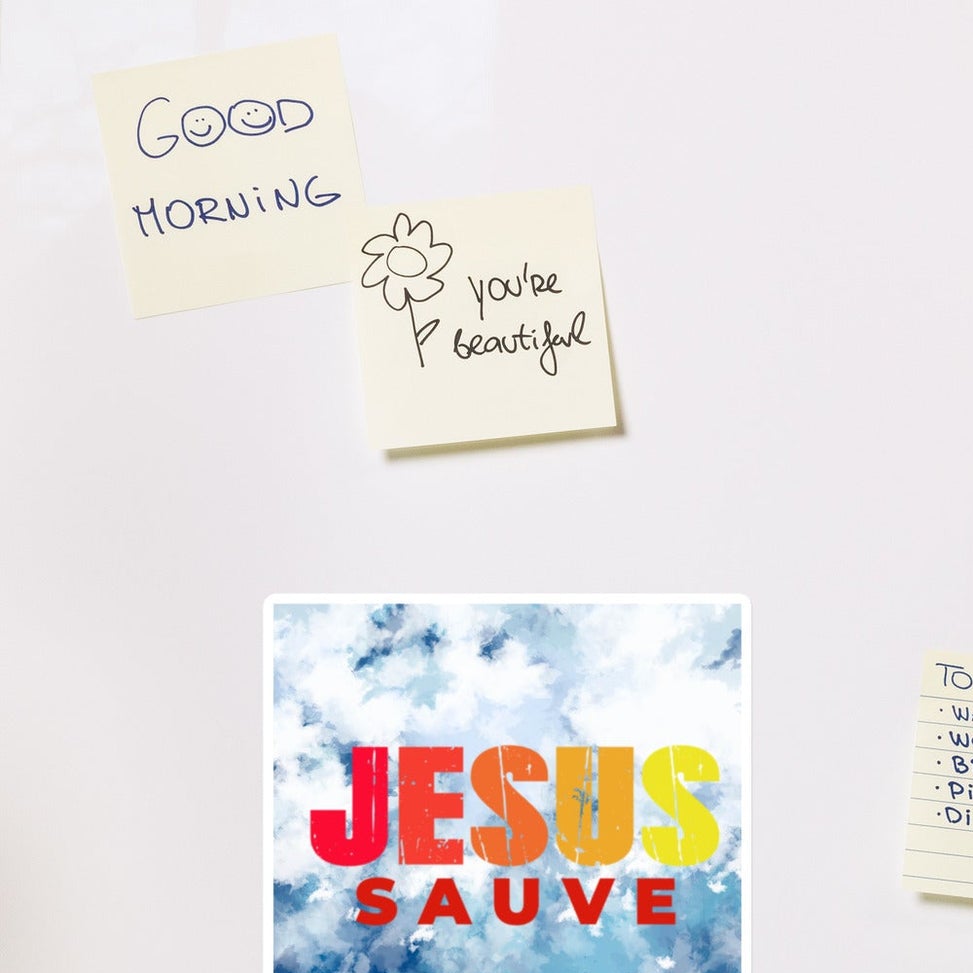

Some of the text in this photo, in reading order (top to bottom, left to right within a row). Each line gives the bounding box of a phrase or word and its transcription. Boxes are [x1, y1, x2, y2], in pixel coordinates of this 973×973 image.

[935, 662, 973, 691] TO
[310, 744, 721, 867] JESUS
[355, 877, 677, 926] SAUVE
